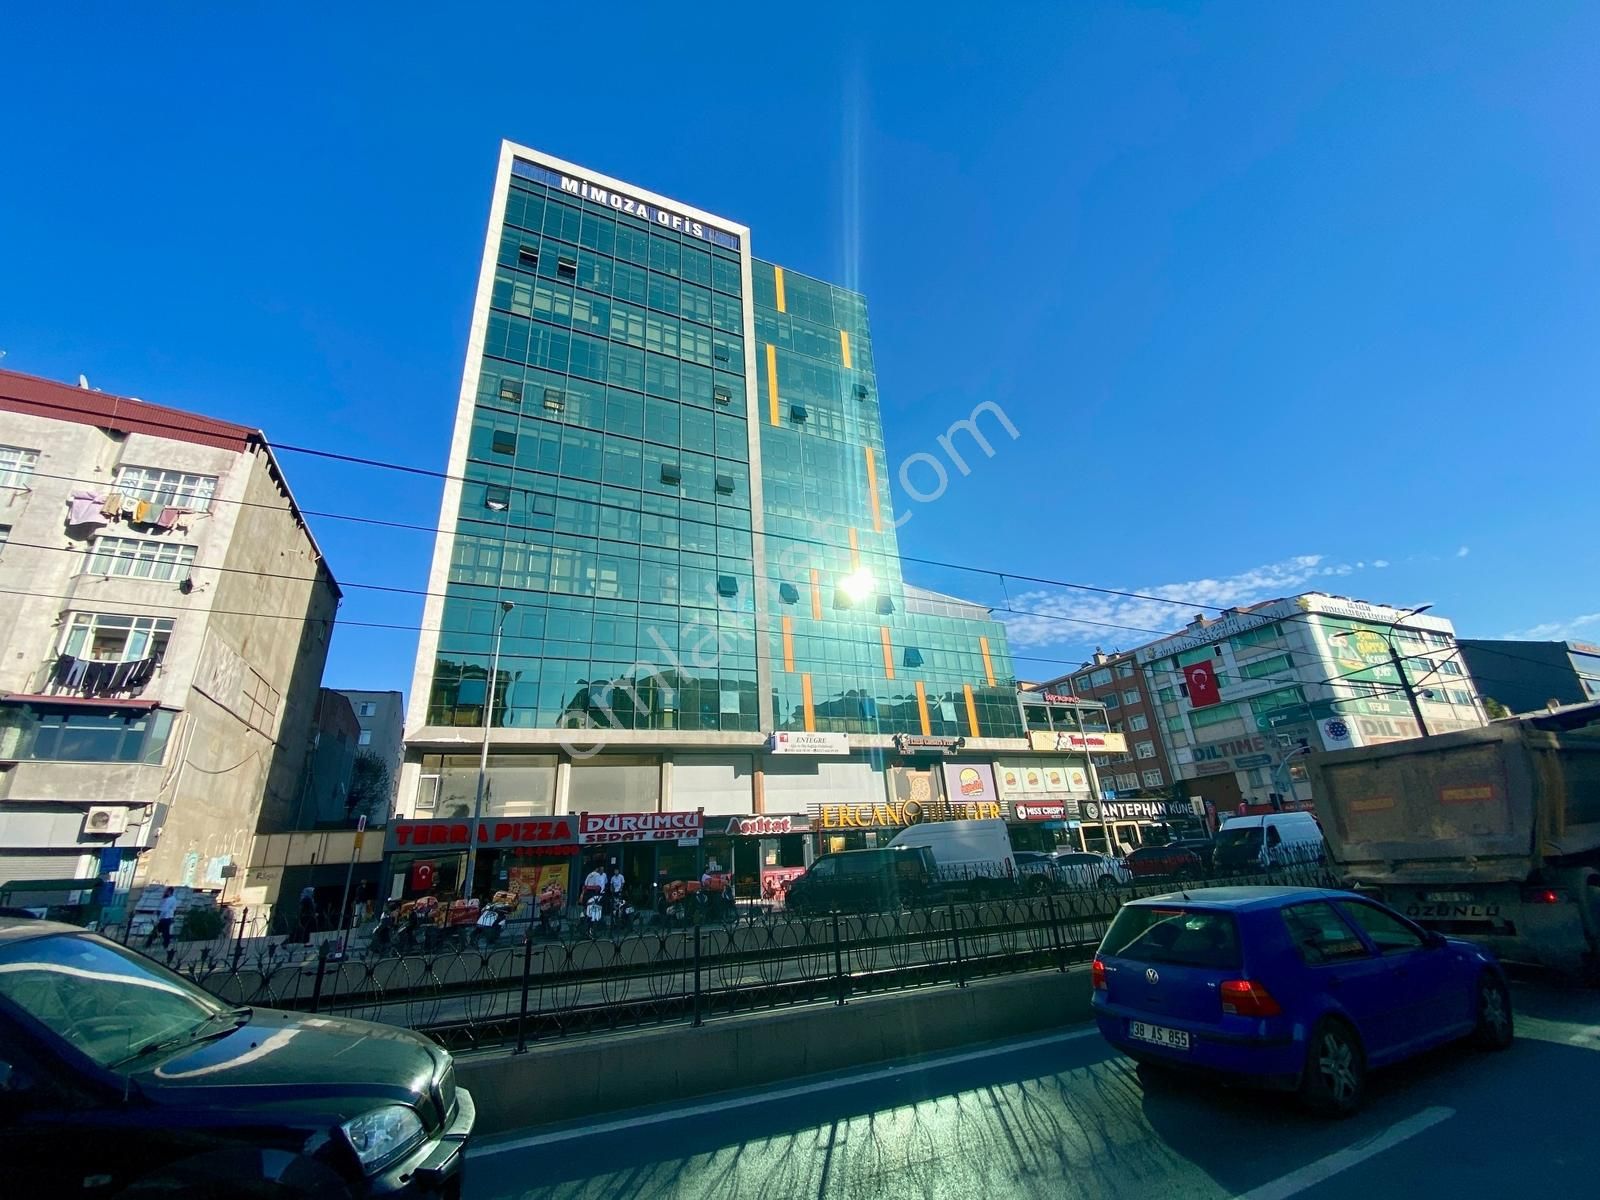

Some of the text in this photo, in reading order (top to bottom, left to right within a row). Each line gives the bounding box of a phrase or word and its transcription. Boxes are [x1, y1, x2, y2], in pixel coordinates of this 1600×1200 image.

[560, 175, 703, 238] MİMOZA OFİS
[796, 736, 827, 744] ENTEGRE
[821, 803, 900, 828] ERCAN
[1101, 801, 1194, 818] ANTEPHAN KÜNE
[587, 811, 700, 832] DÜRÜMCÜ
[395, 820, 572, 846] TERRA PIZZA
[585, 831, 647, 843] SEDAT
[1406, 902, 1500, 917] ÖZÜNLÜ
[1133, 1022, 1145, 1037] 38
[1151, 1027, 1163, 1041] AS
[1168, 1030, 1188, 1046] 855
